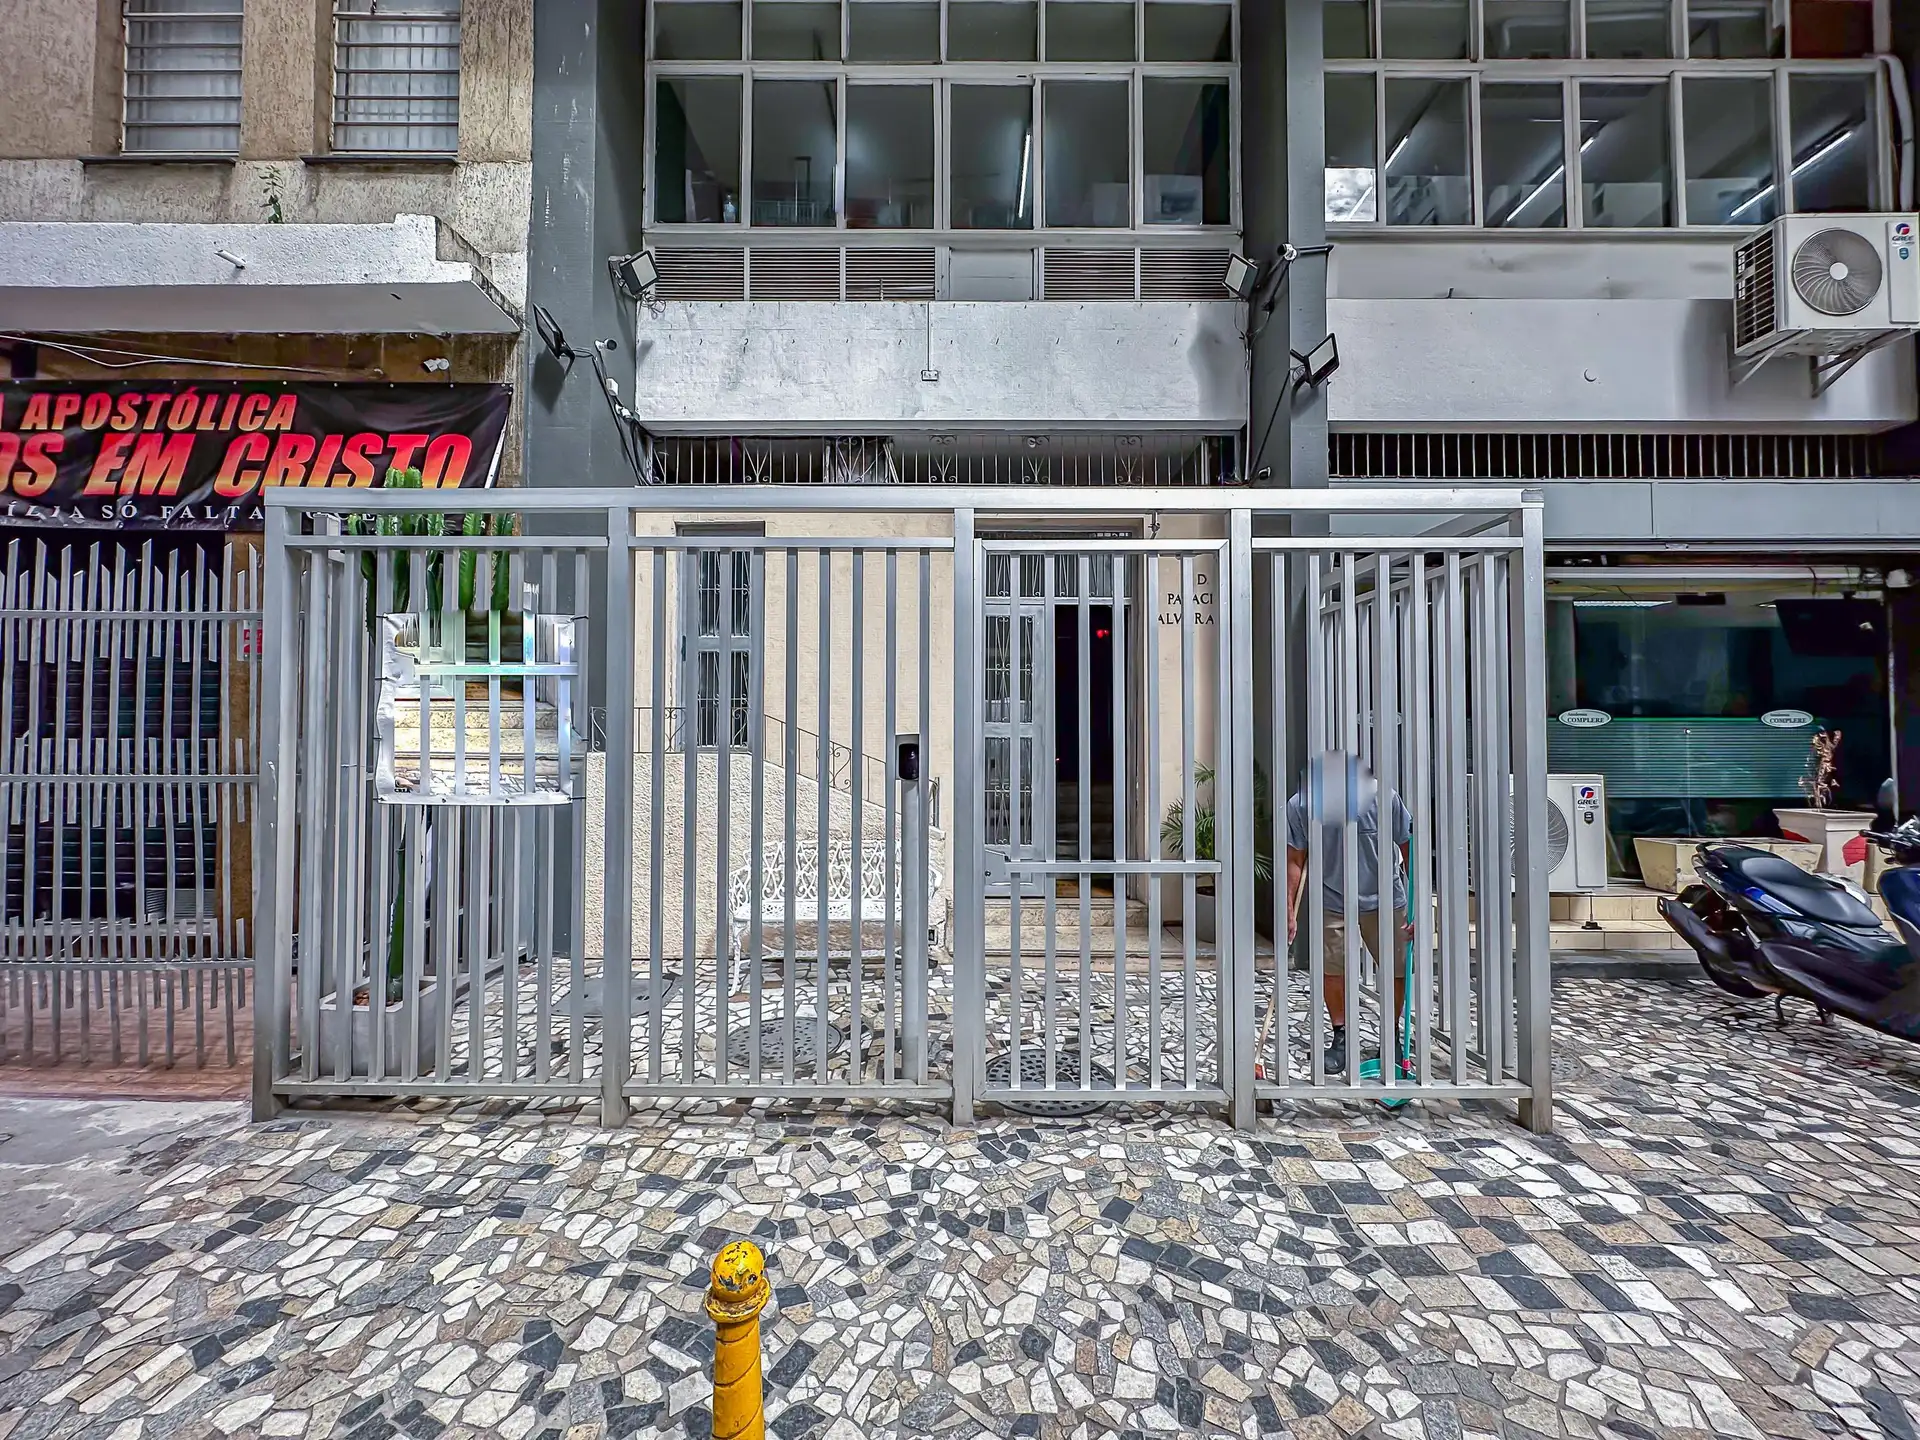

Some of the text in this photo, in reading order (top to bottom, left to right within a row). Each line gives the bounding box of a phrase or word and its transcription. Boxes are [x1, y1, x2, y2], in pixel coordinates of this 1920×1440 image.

[19, 385, 298, 431] APOSTÓLICA
[82, 432, 197, 497] EM
[213, 431, 473, 498] CRISTO
[101, 501, 138, 520] SÓ
[160, 505, 265, 521] FALTA
[1167, 593, 1214, 605] PAACI
[1157, 612, 1215, 625] ALVRA
